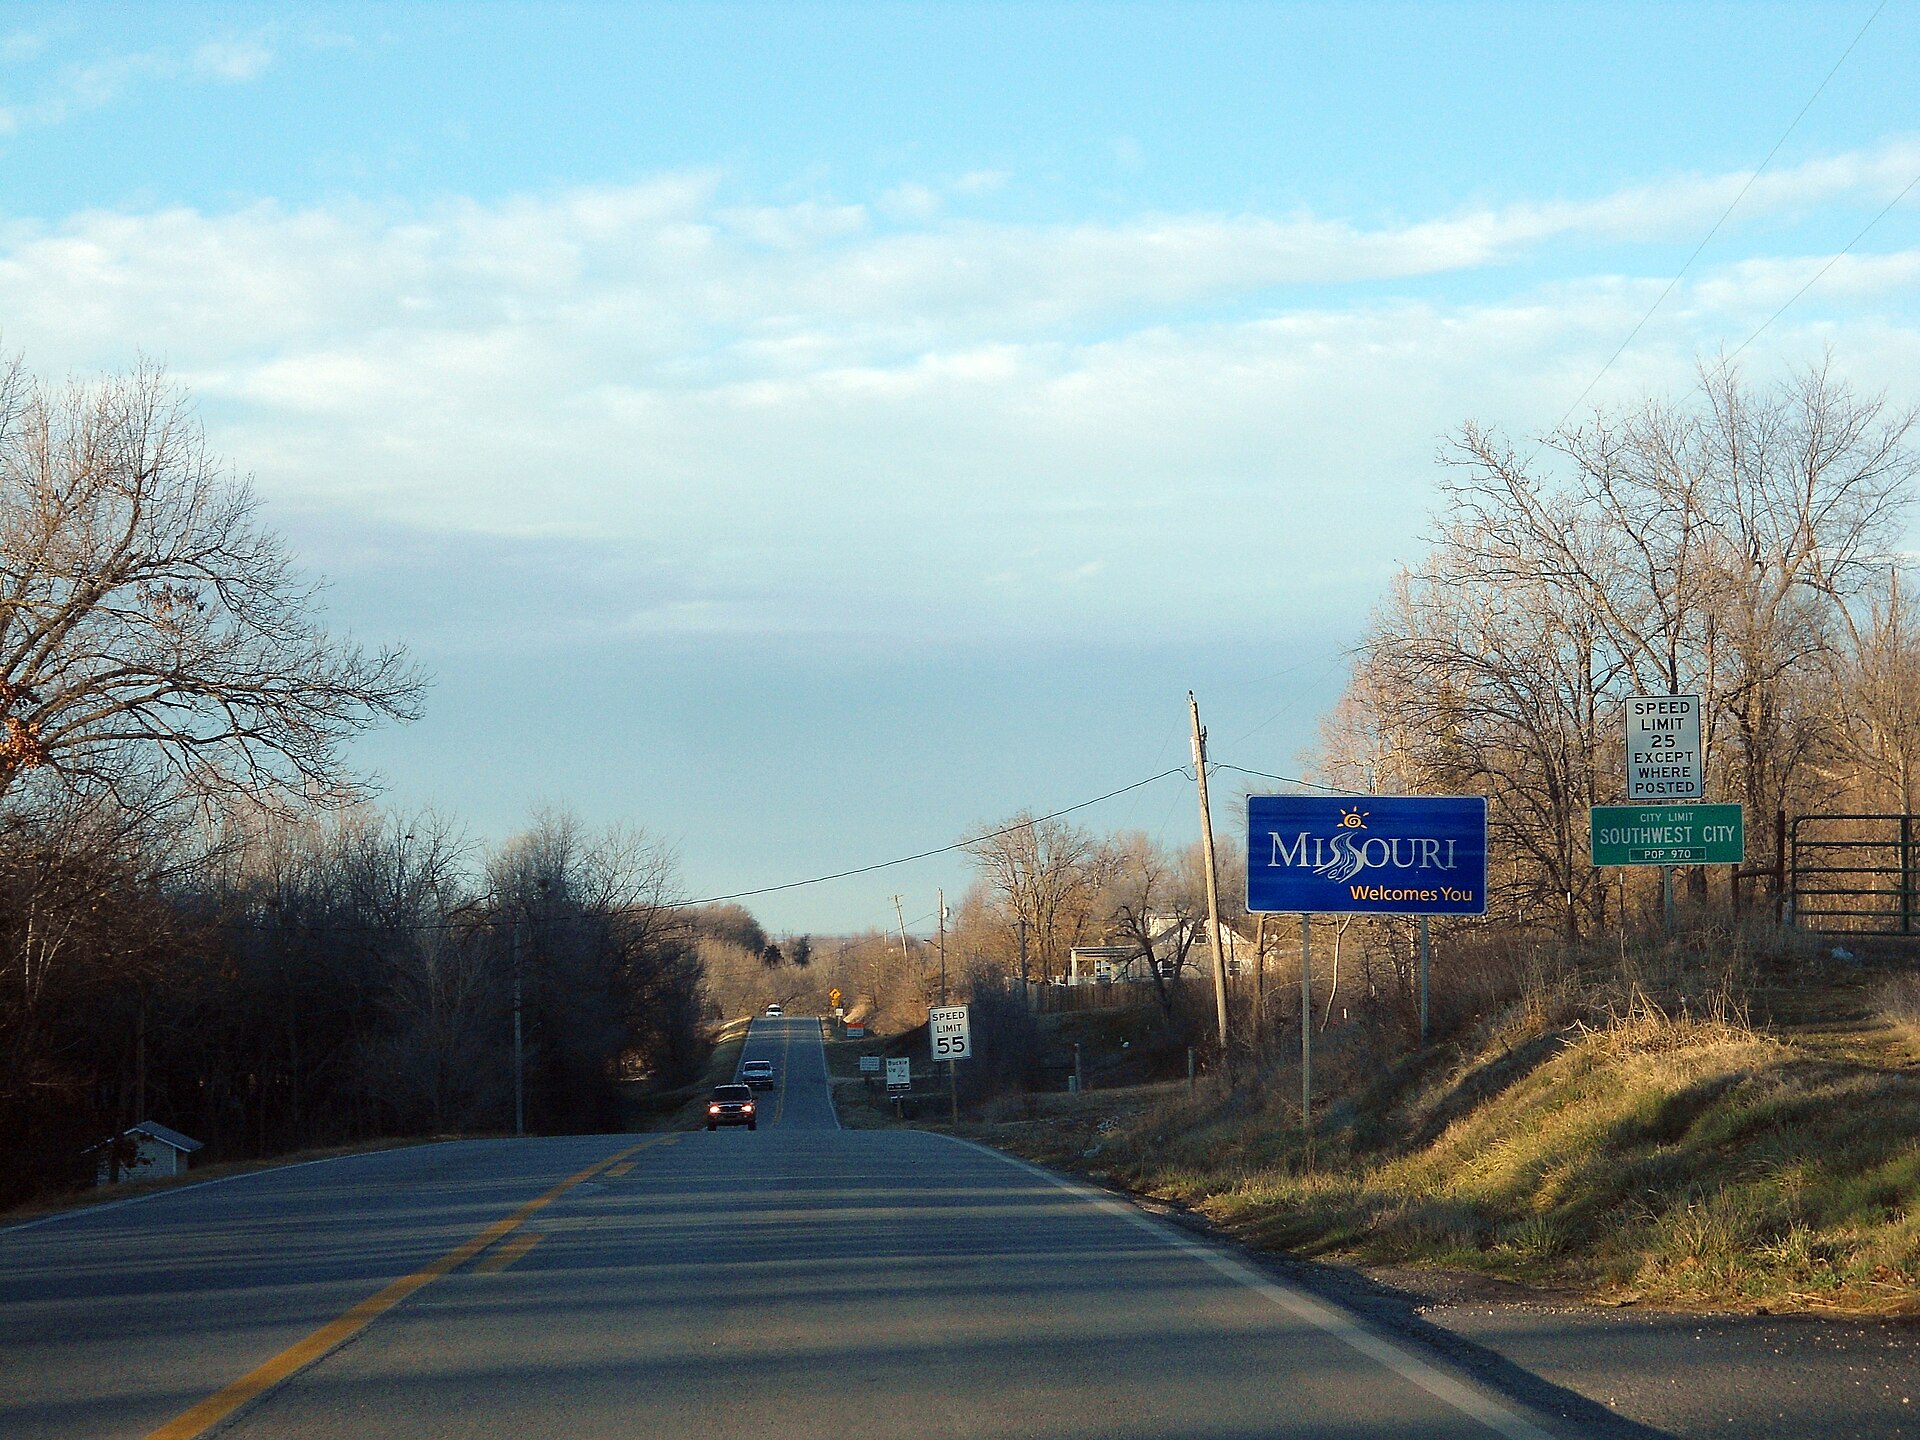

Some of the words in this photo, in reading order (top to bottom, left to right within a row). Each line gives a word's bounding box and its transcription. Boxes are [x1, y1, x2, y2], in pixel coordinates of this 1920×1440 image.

[1634, 701, 1690, 715] SPEED
[1641, 717, 1685, 731] LIMIT
[1651, 734, 1676, 748] 25
[1634, 751, 1694, 764] EXCEPT
[1638, 766, 1691, 779] WHERE
[1635, 781, 1695, 794] POSTED
[1640, 813, 1662, 823] CITY
[1668, 812, 1694, 822] LIMIT
[1600, 826, 1693, 845] SOUTHWEST
[1703, 825, 1735, 843] CITY
[1644, 850, 1665, 859] POP
[1671, 849, 1691, 859] 970
[1350, 885, 1438, 901] Welcomes
[1440, 886, 1473, 902] You
[932, 1011, 965, 1022] SPEED
[937, 1023, 962, 1034] LIMIT
[937, 1036, 965, 1055] 55
